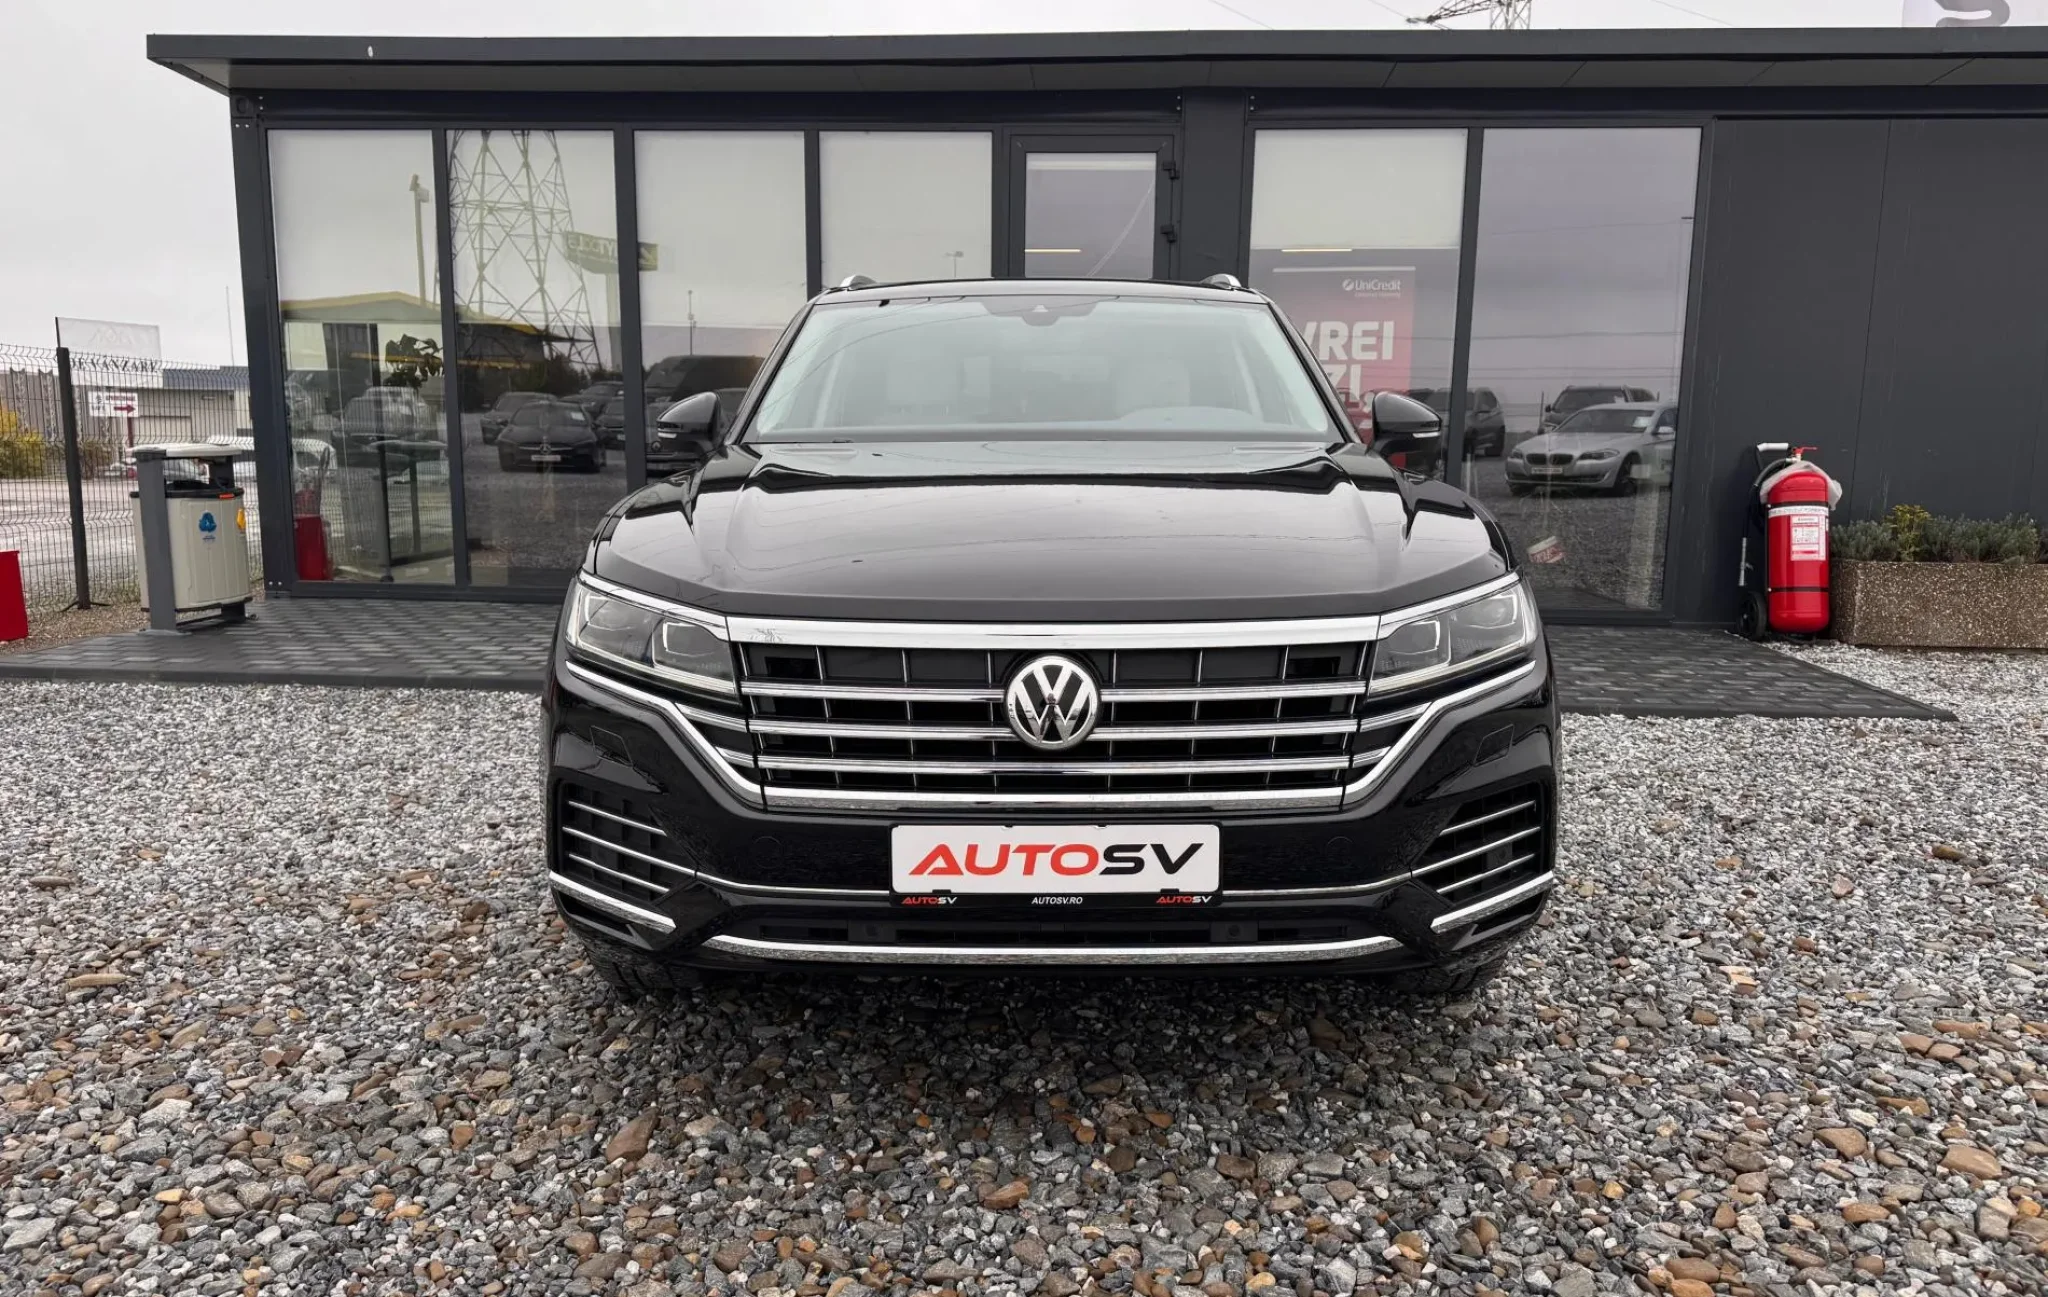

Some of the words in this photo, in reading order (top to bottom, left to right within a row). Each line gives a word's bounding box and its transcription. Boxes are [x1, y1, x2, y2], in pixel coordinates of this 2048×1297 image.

[1355, 279, 1401, 291] UniCredit
[908, 842, 1204, 876] AUTOSV
[901, 896, 958, 905] AUTOSV
[1031, 896, 1083, 905] AUTOSV.RO
[1156, 895, 1212, 904] AUTOSV
